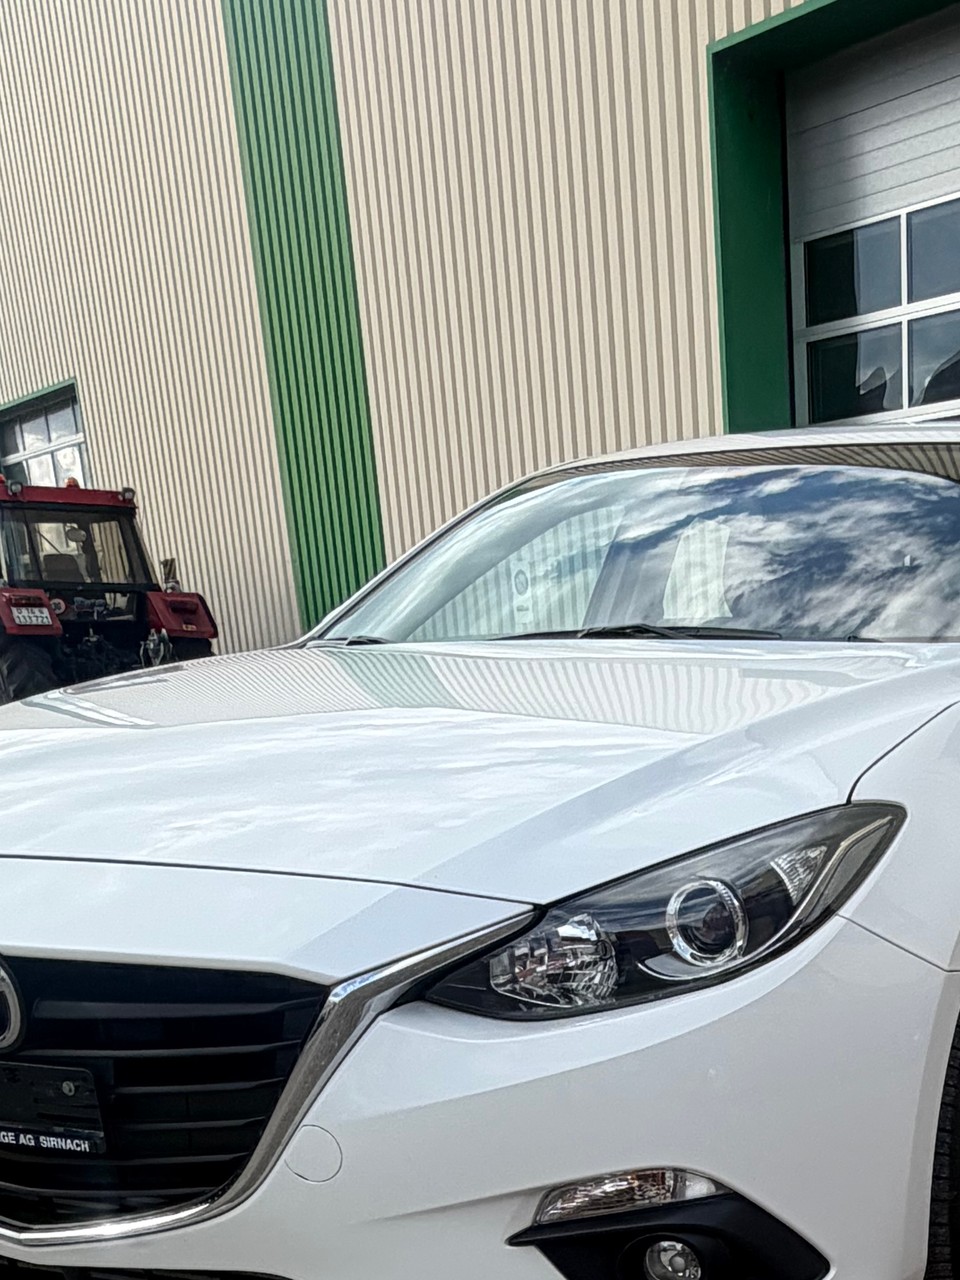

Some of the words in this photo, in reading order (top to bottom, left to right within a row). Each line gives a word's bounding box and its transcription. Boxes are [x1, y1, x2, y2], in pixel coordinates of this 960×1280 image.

[0, 1131, 16, 1144] GE
[19, 1133, 35, 1146] AG
[39, 1136, 90, 1153] SIRNACH
